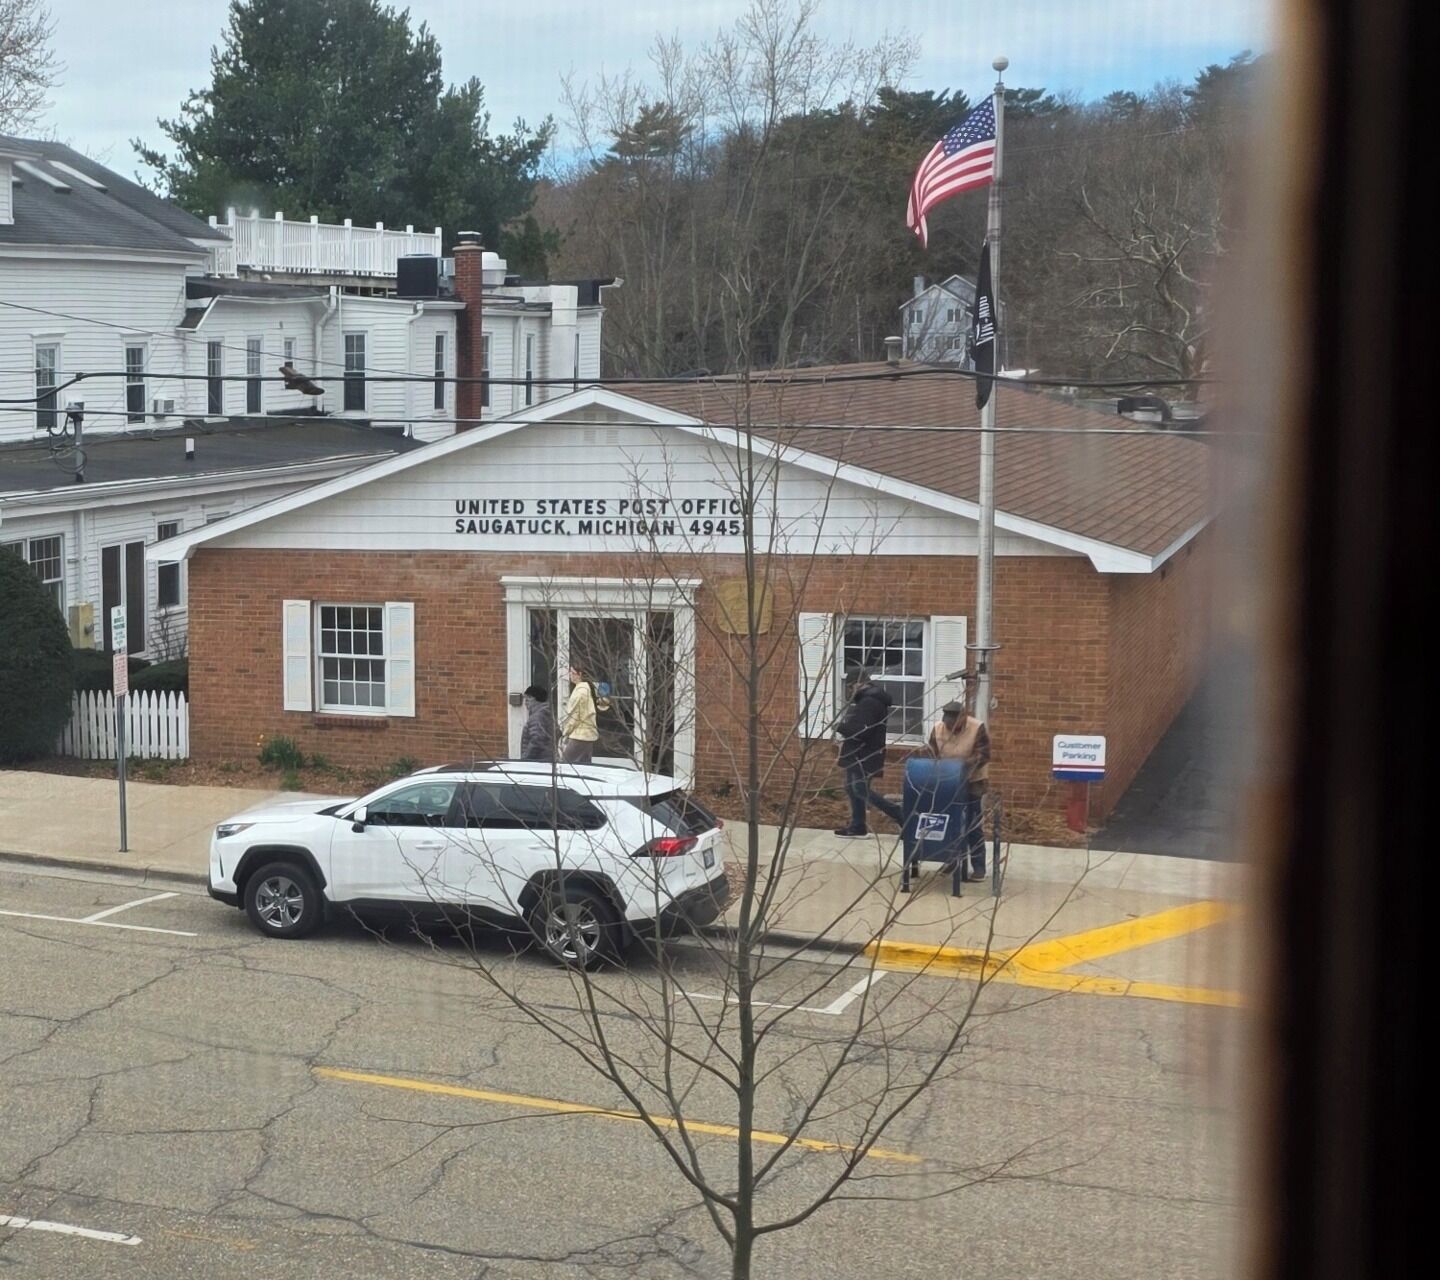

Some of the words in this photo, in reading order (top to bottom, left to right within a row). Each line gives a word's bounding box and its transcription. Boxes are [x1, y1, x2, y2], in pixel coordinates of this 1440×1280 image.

[455, 499, 525, 515] UNITED
[536, 499, 607, 515] STATES
[619, 499, 670, 515] POST
[681, 499, 747, 515] OFFIC
[455, 519, 571, 536] SAUGATUCK,
[578, 519, 674, 536] MICHIGAN
[689, 519, 746, 536] 4945
[1058, 741, 1101, 750] Customer
[1062, 752, 1097, 761] Parking
